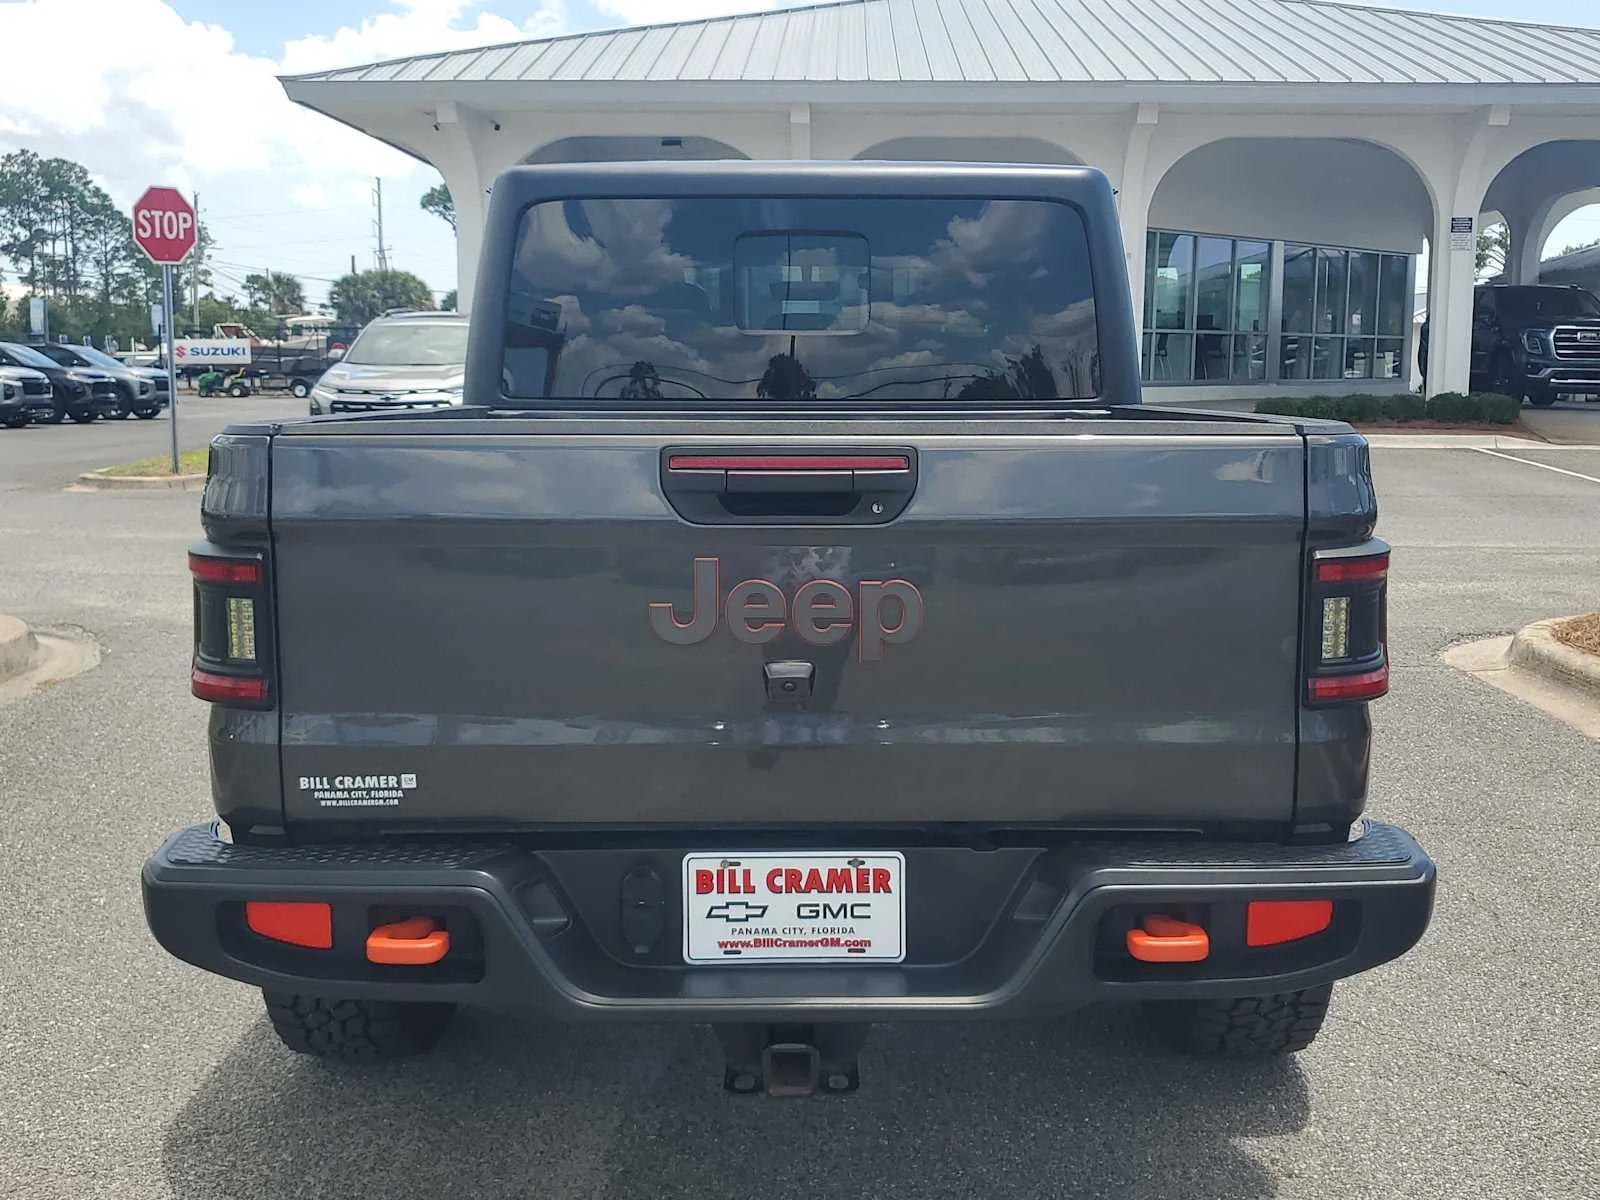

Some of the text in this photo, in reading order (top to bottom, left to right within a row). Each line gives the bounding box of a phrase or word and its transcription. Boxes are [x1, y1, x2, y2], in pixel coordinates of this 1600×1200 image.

[138, 209, 192, 239] STOP
[190, 346, 246, 356] SUZUKI
[649, 557, 924, 663] Jeep
[299, 775, 398, 789] BILL CRAMER
[314, 790, 403, 799] PANAMA CITY, FLORIDA
[695, 867, 892, 894] BILL CRAMER
[796, 903, 871, 919] GMC
[731, 926, 855, 936] PANAMA CITY, FLORIDA
[717, 937, 872, 949] www.BillCramerGM.com
